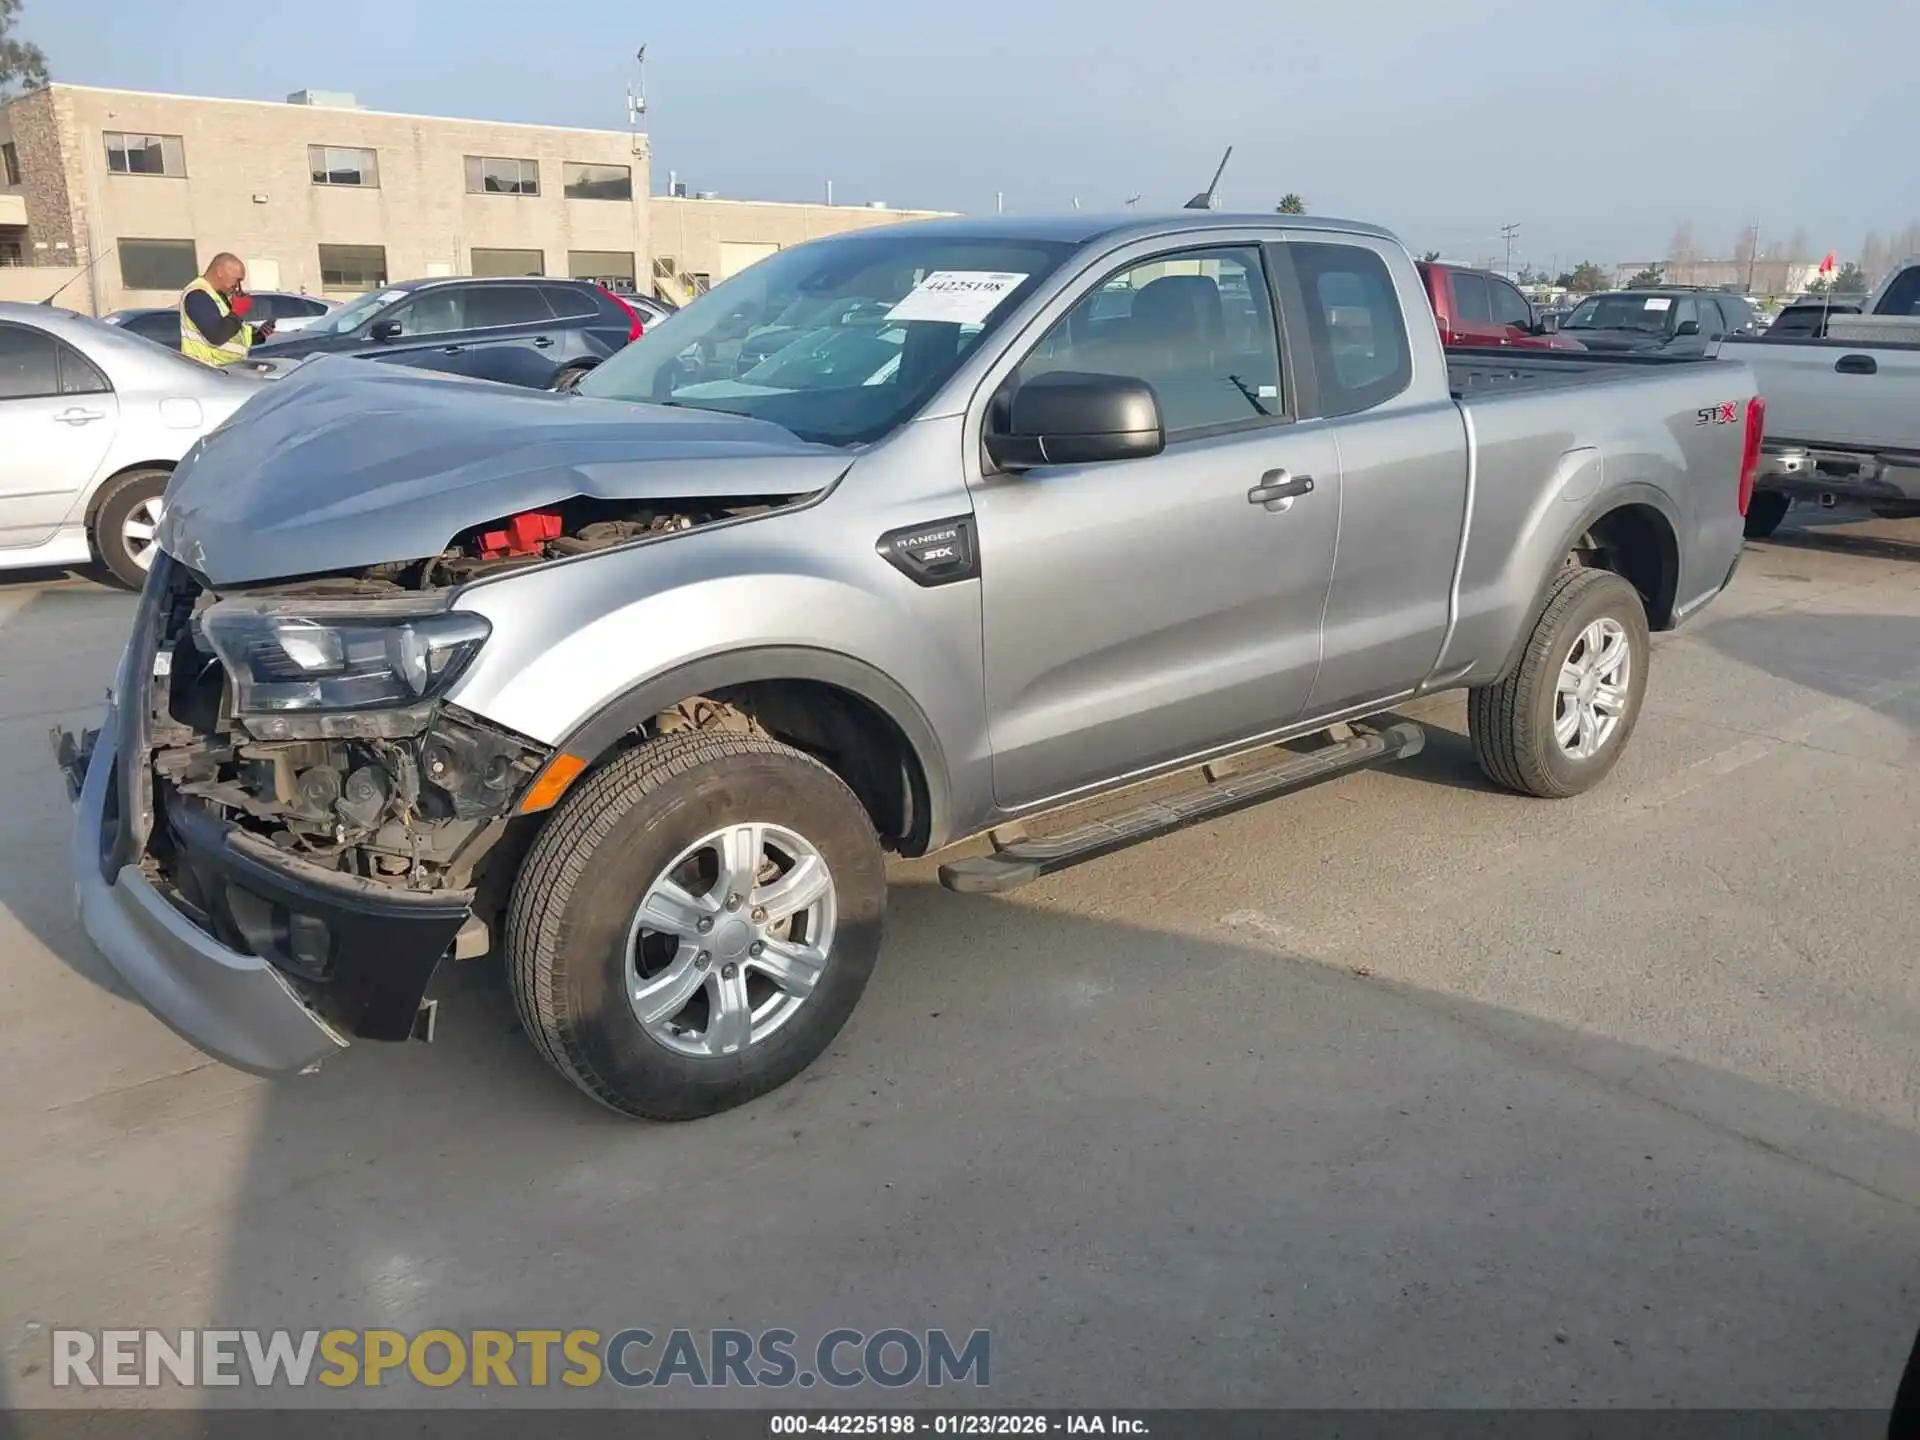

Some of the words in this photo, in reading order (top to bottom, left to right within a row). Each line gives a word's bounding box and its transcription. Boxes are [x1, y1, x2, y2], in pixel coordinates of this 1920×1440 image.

[926, 281, 1004, 291] 44225198
[1696, 400, 1737, 424] STX
[896, 530, 957, 547] RANGER
[923, 546, 953, 561] STX
